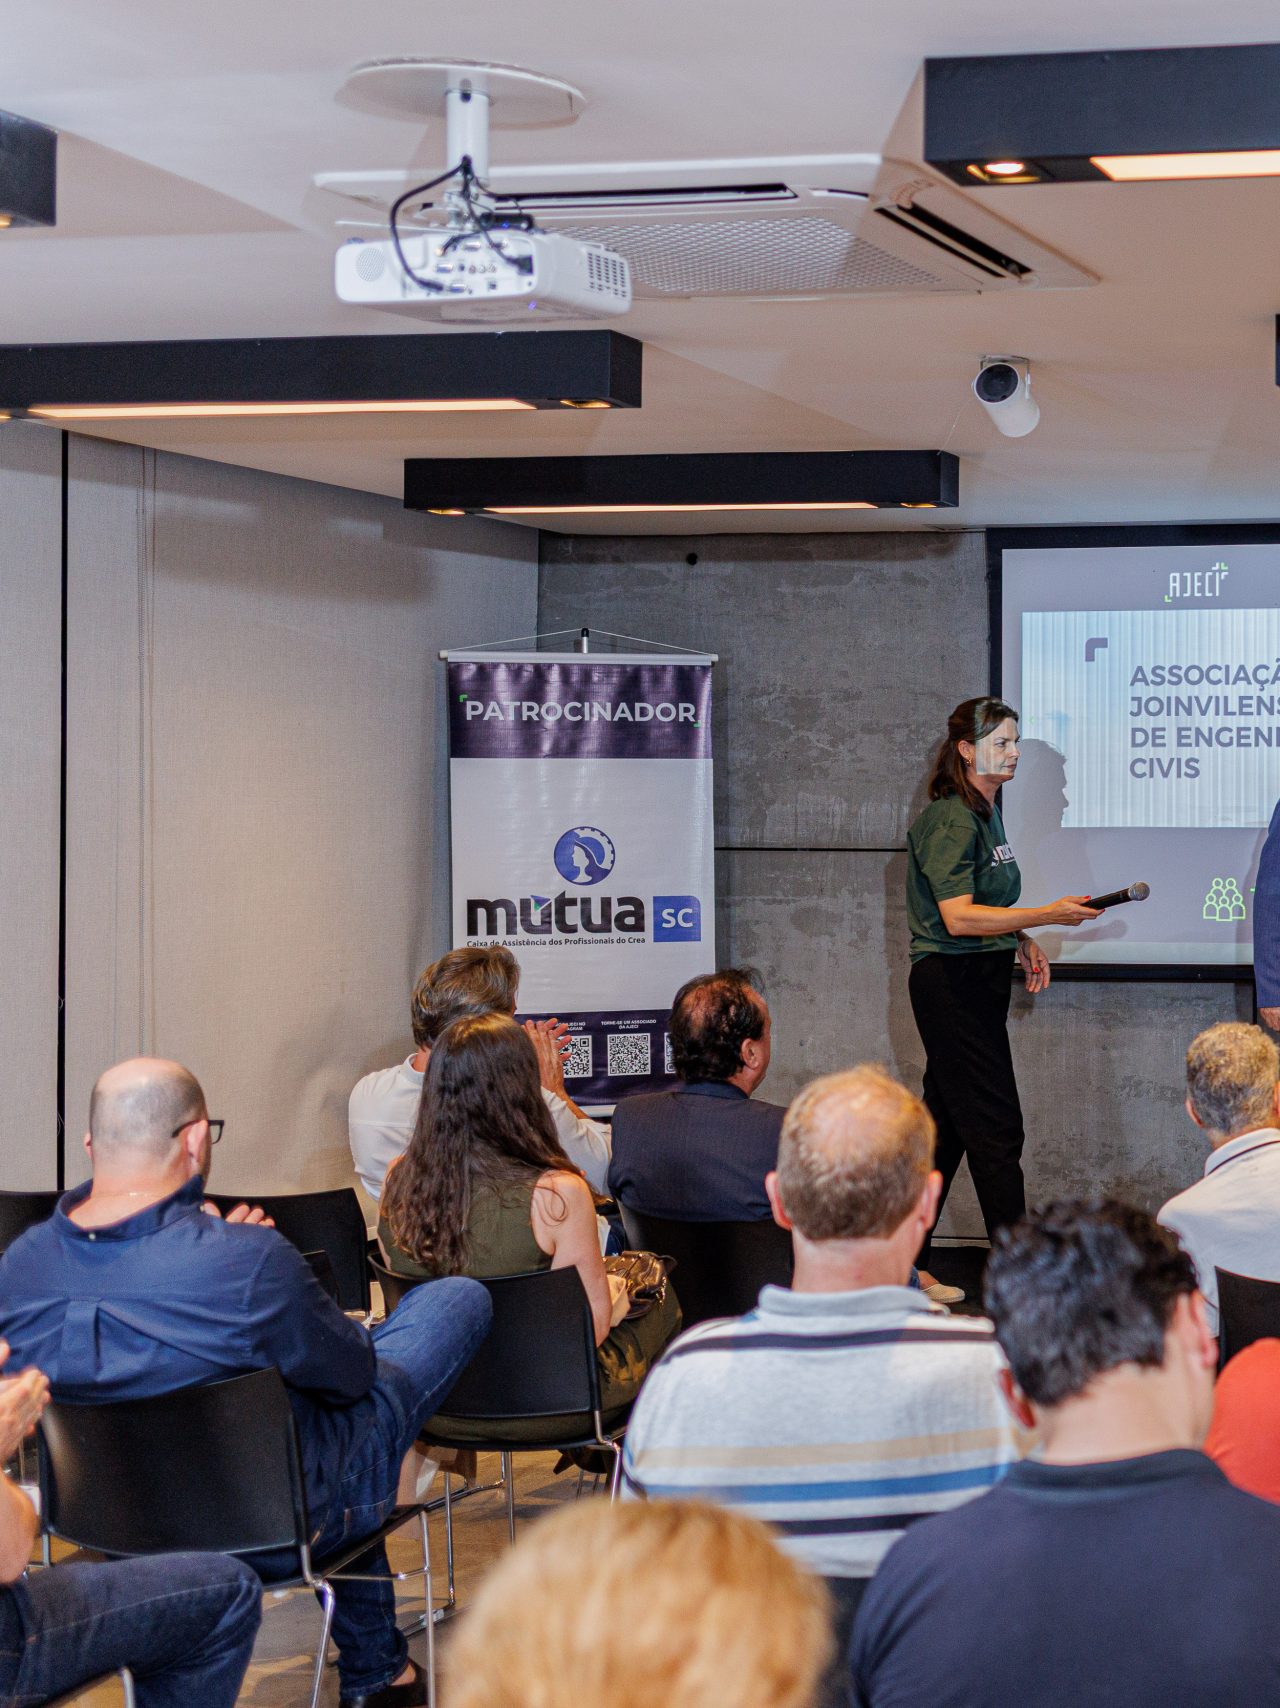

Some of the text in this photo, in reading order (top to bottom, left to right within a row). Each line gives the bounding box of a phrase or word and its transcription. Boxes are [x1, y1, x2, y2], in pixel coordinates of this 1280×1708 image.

[465, 700, 696, 723] PATROCINADOR
[1131, 727, 1167, 748] DE
[1129, 757, 1200, 779] CIVIS
[661, 908, 694, 929] SC
[466, 936, 646, 948] Caixa de Assistência dos Profissionais do Crea
